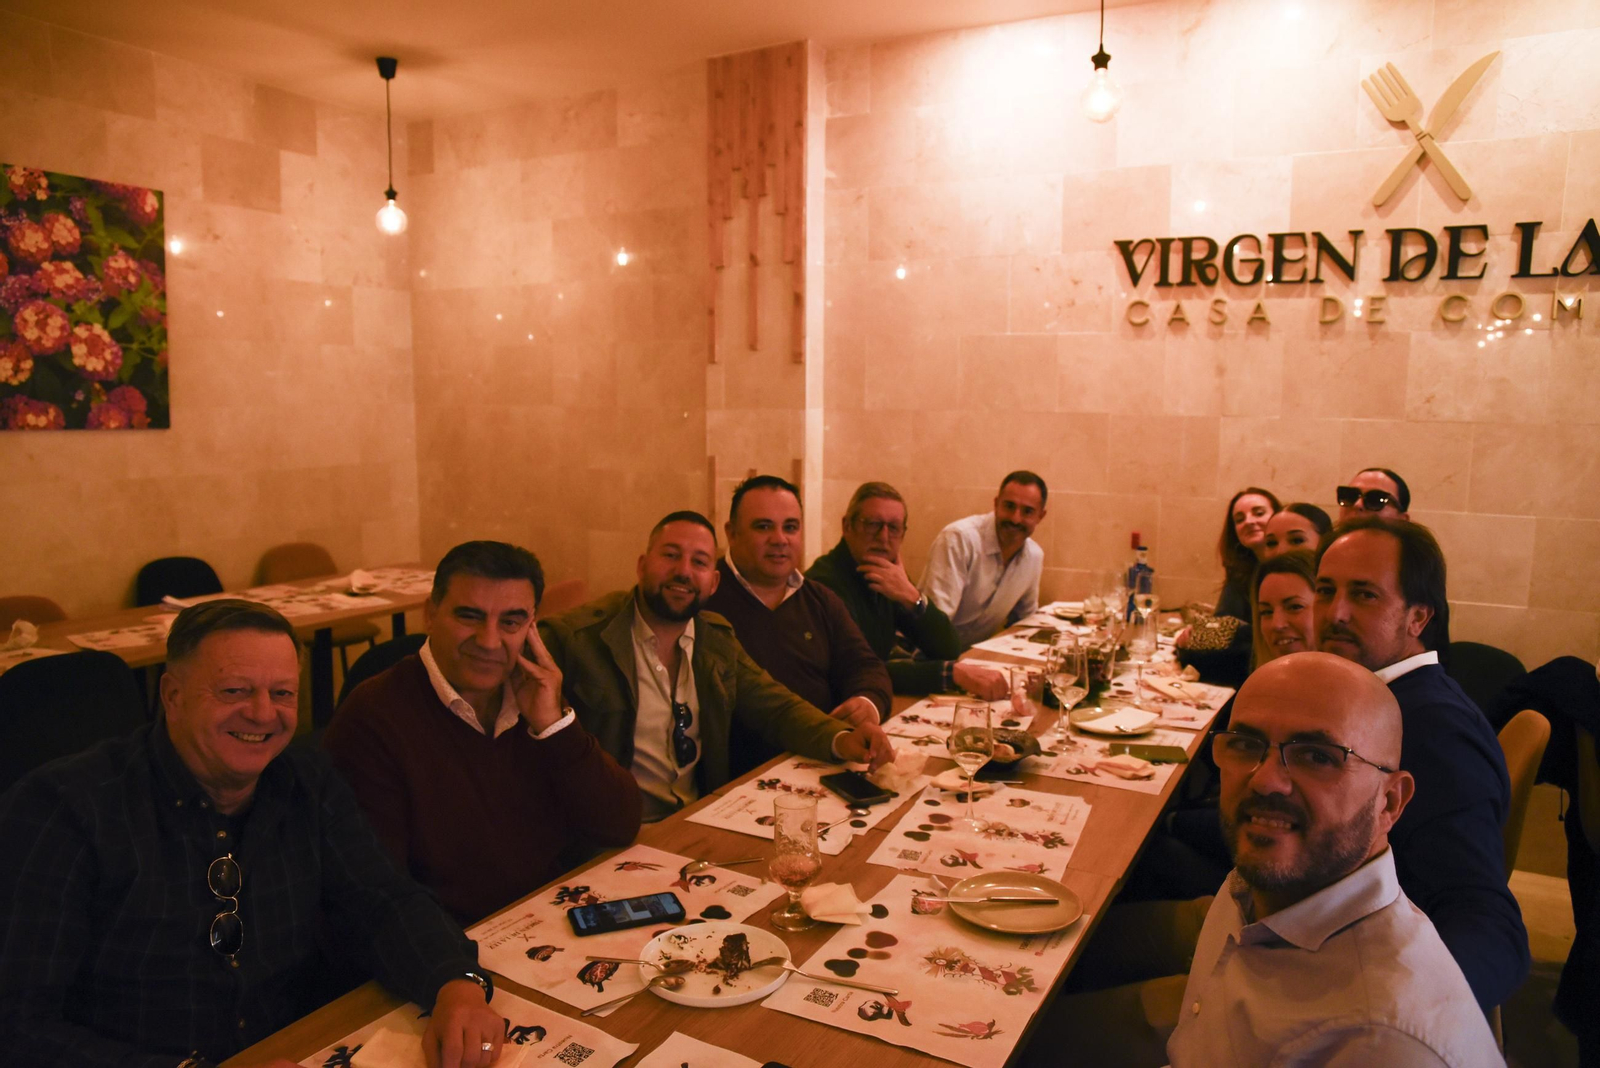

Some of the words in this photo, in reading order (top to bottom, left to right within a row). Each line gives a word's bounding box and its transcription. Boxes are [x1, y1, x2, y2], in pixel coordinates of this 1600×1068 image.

[1114, 230, 1364, 287] VIRGEN
[1384, 224, 1489, 282] DE
[1511, 217, 1600, 278] LA
[1128, 299, 1271, 326] CASA
[1319, 295, 1386, 323] DE
[537, 1048, 553, 1059] Carta
[552, 1034, 573, 1050] Nuestra
